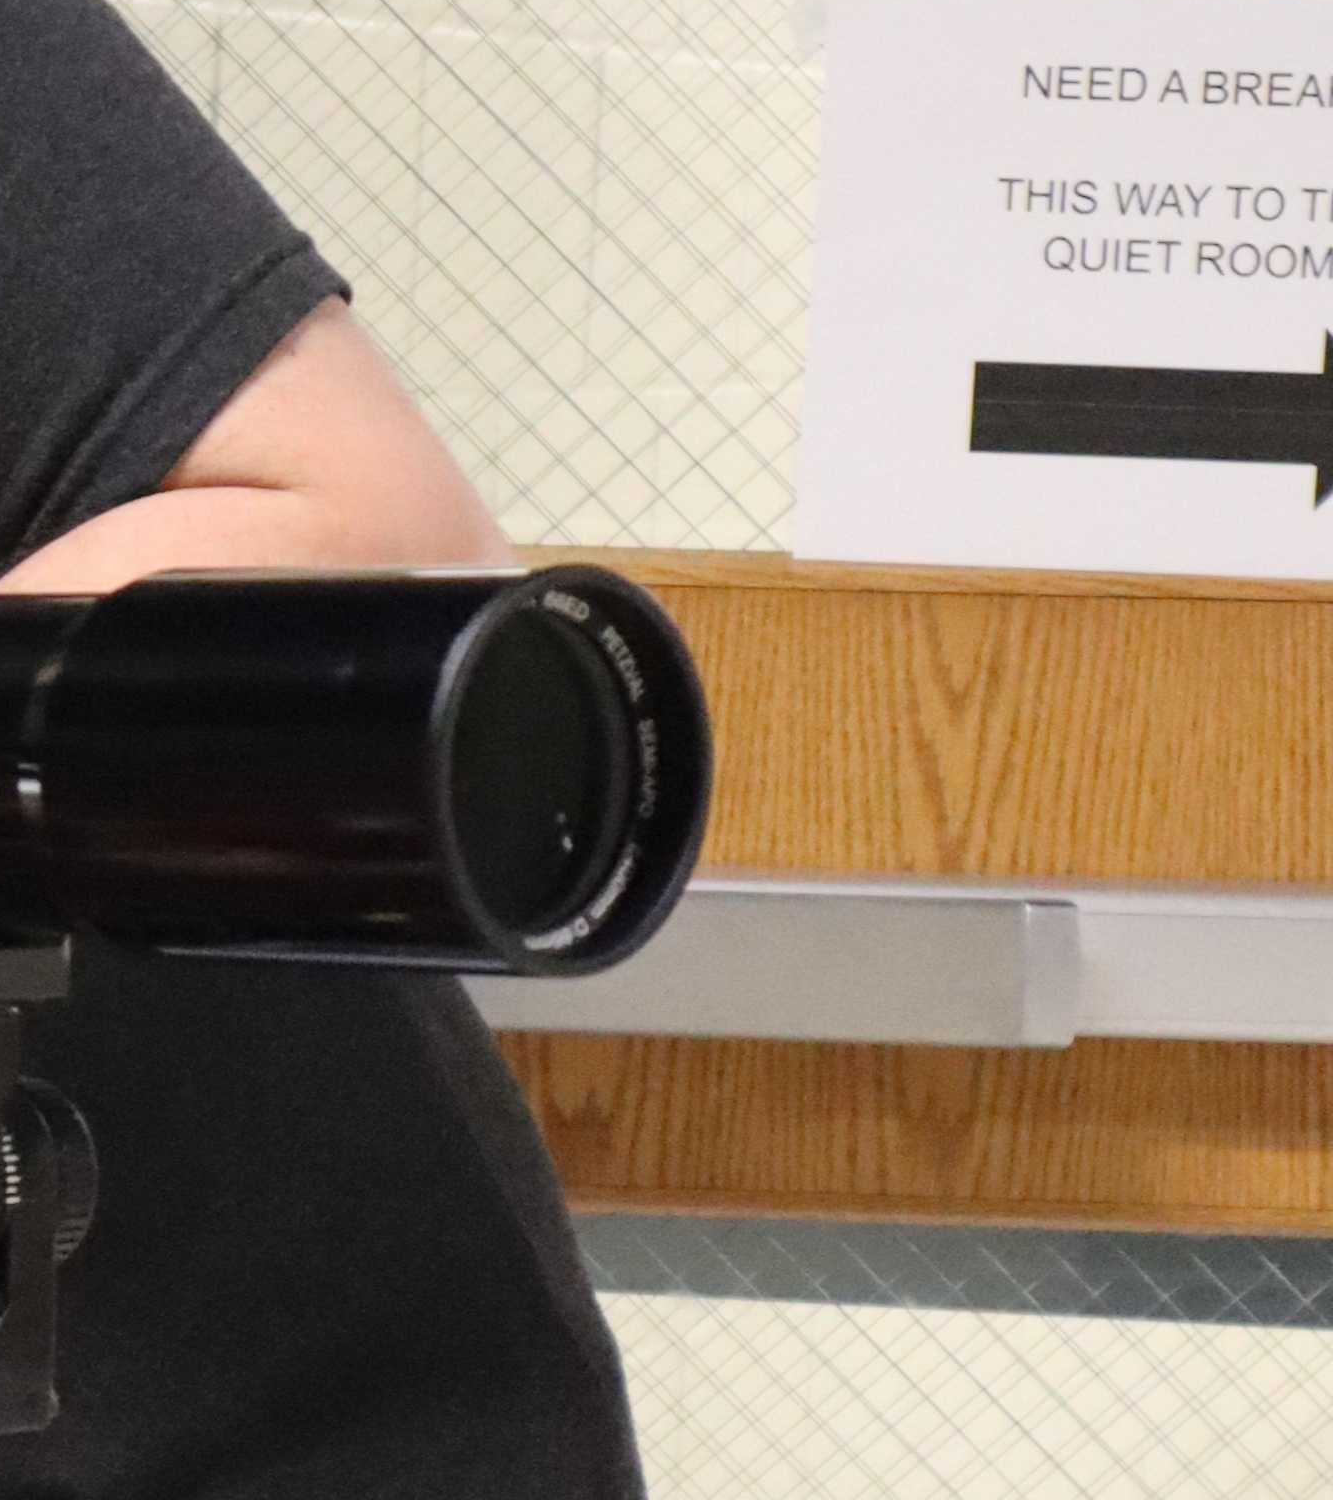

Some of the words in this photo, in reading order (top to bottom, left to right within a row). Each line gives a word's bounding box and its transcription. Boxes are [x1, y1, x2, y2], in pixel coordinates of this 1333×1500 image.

[1021, 64, 1149, 102] NEED
[1157, 68, 1190, 104] A
[1201, 69, 1333, 109] BREA
[997, 177, 1099, 216] THIS
[1114, 182, 1213, 219] WAY
[1226, 184, 1286, 223] TO
[1301, 187, 1333, 223] T
[1043, 235, 1183, 275] QUIET
[1195, 241, 1333, 280] ROOM
